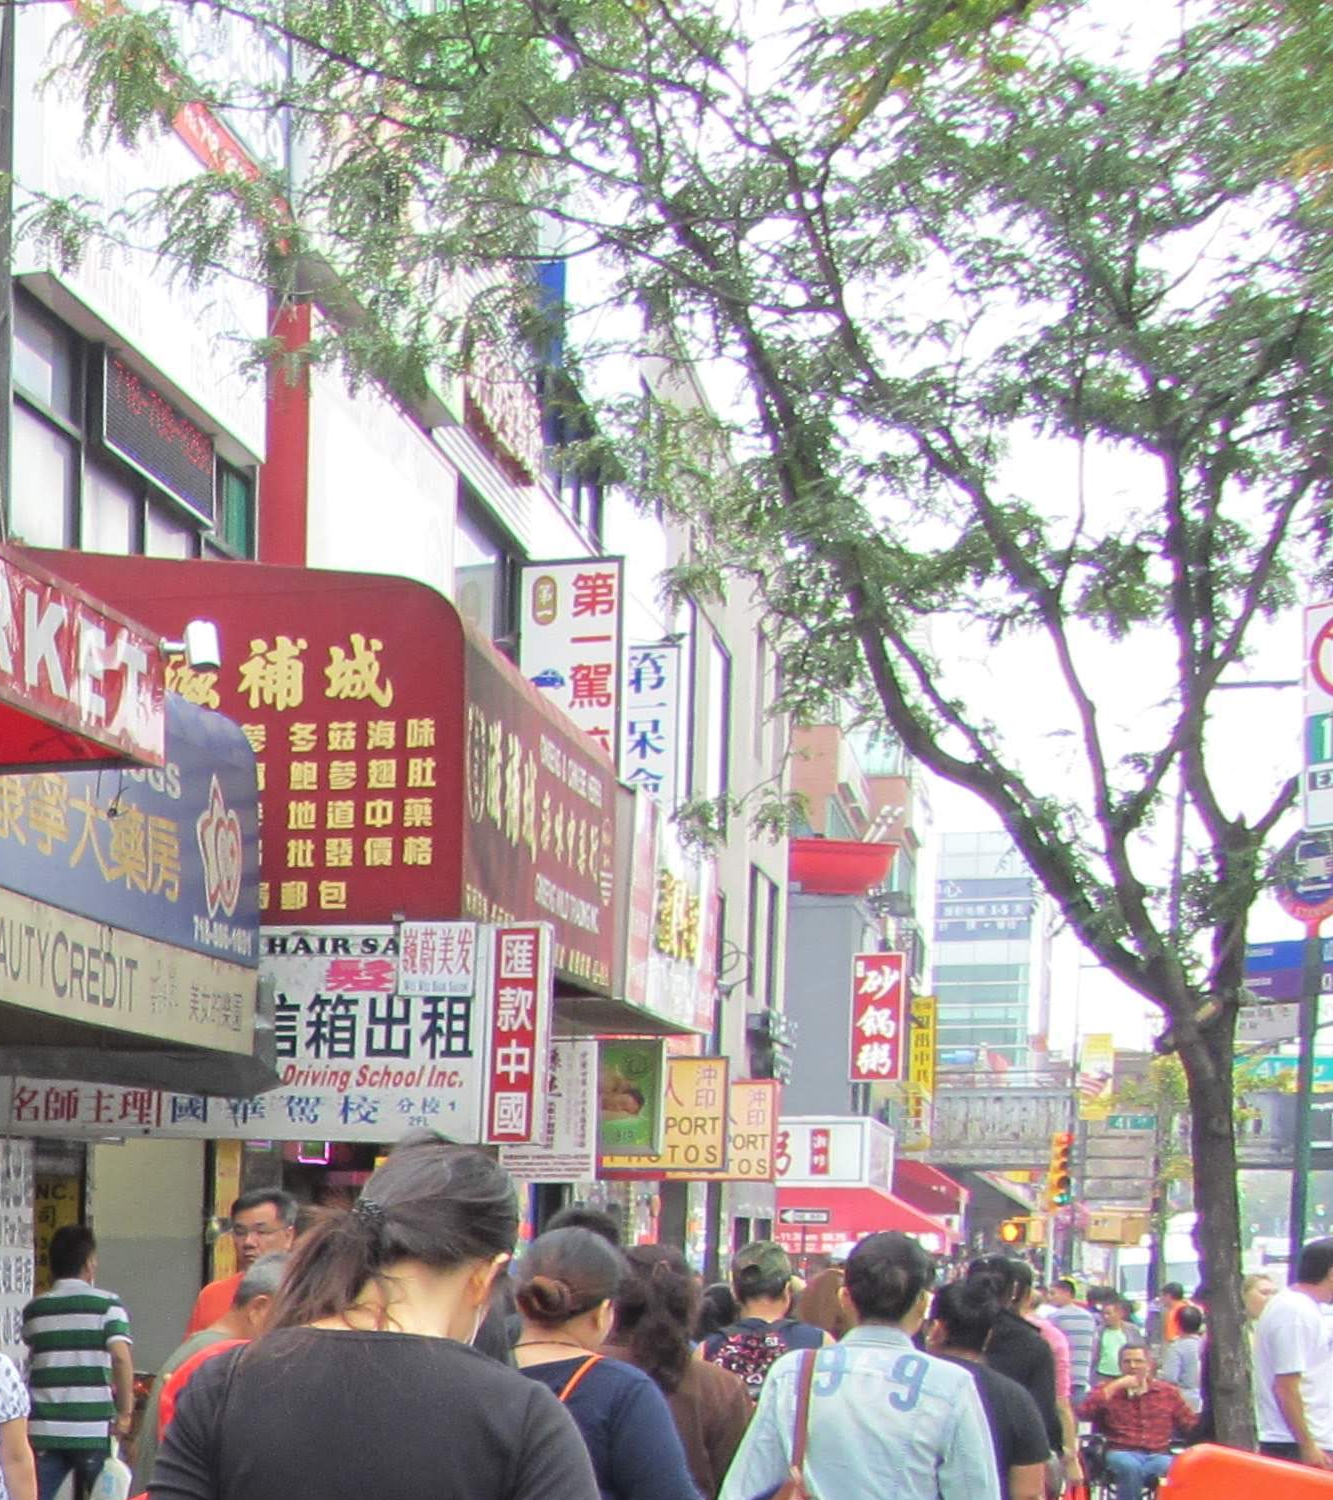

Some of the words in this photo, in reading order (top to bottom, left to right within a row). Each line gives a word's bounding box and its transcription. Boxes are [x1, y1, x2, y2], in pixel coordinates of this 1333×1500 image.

[288, 718, 436, 753] 冬菇海味
[287, 798, 433, 830] 地道中藥
[286, 836, 433, 868] 批發價格
[268, 937, 352, 955] HAIR
[494, 933, 534, 1137] 匯款中國
[283, 1064, 351, 1093] Driving
[355, 1063, 425, 1088] School
[427, 1067, 464, 1089] Inc.
[13, 1085, 153, 1127] 名師主理
[888, 1353, 930, 1412] 9
